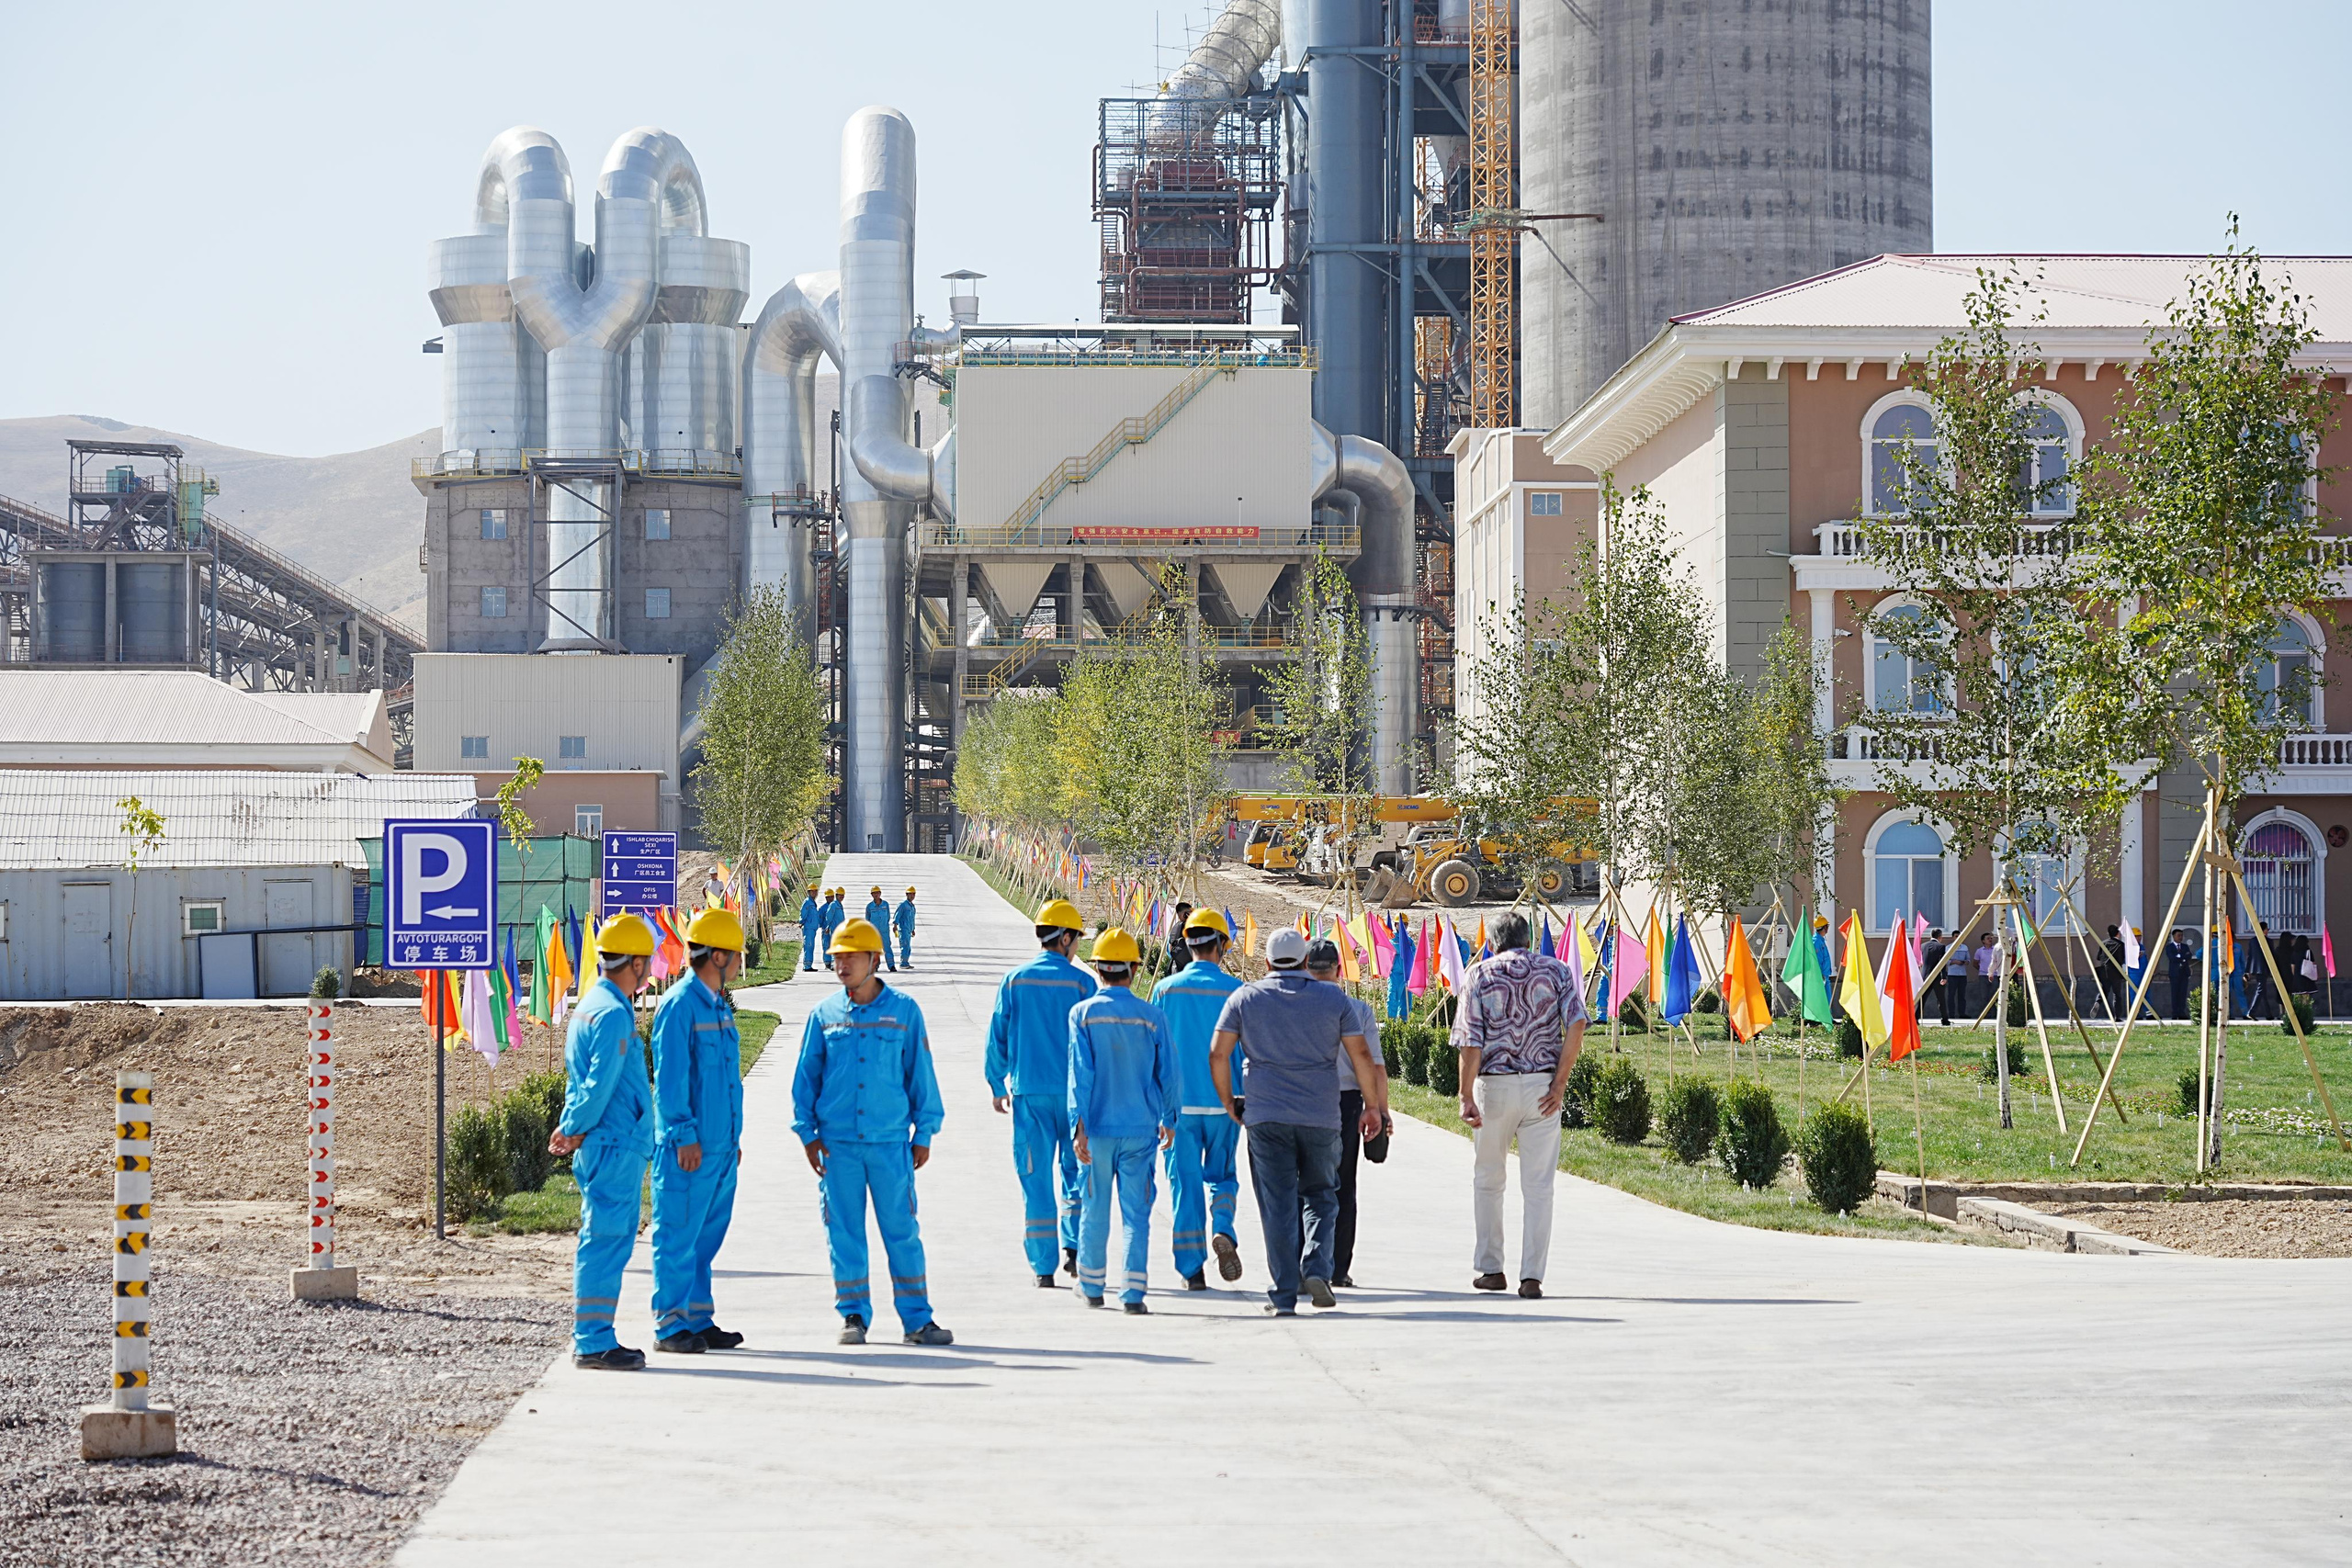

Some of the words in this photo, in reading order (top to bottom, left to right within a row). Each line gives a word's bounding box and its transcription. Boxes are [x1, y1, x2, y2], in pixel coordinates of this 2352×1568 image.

[401, 833, 468, 924] P
[397, 933, 482, 943] AVTOTURARGOH
[404, 945, 477, 963] 停车场
